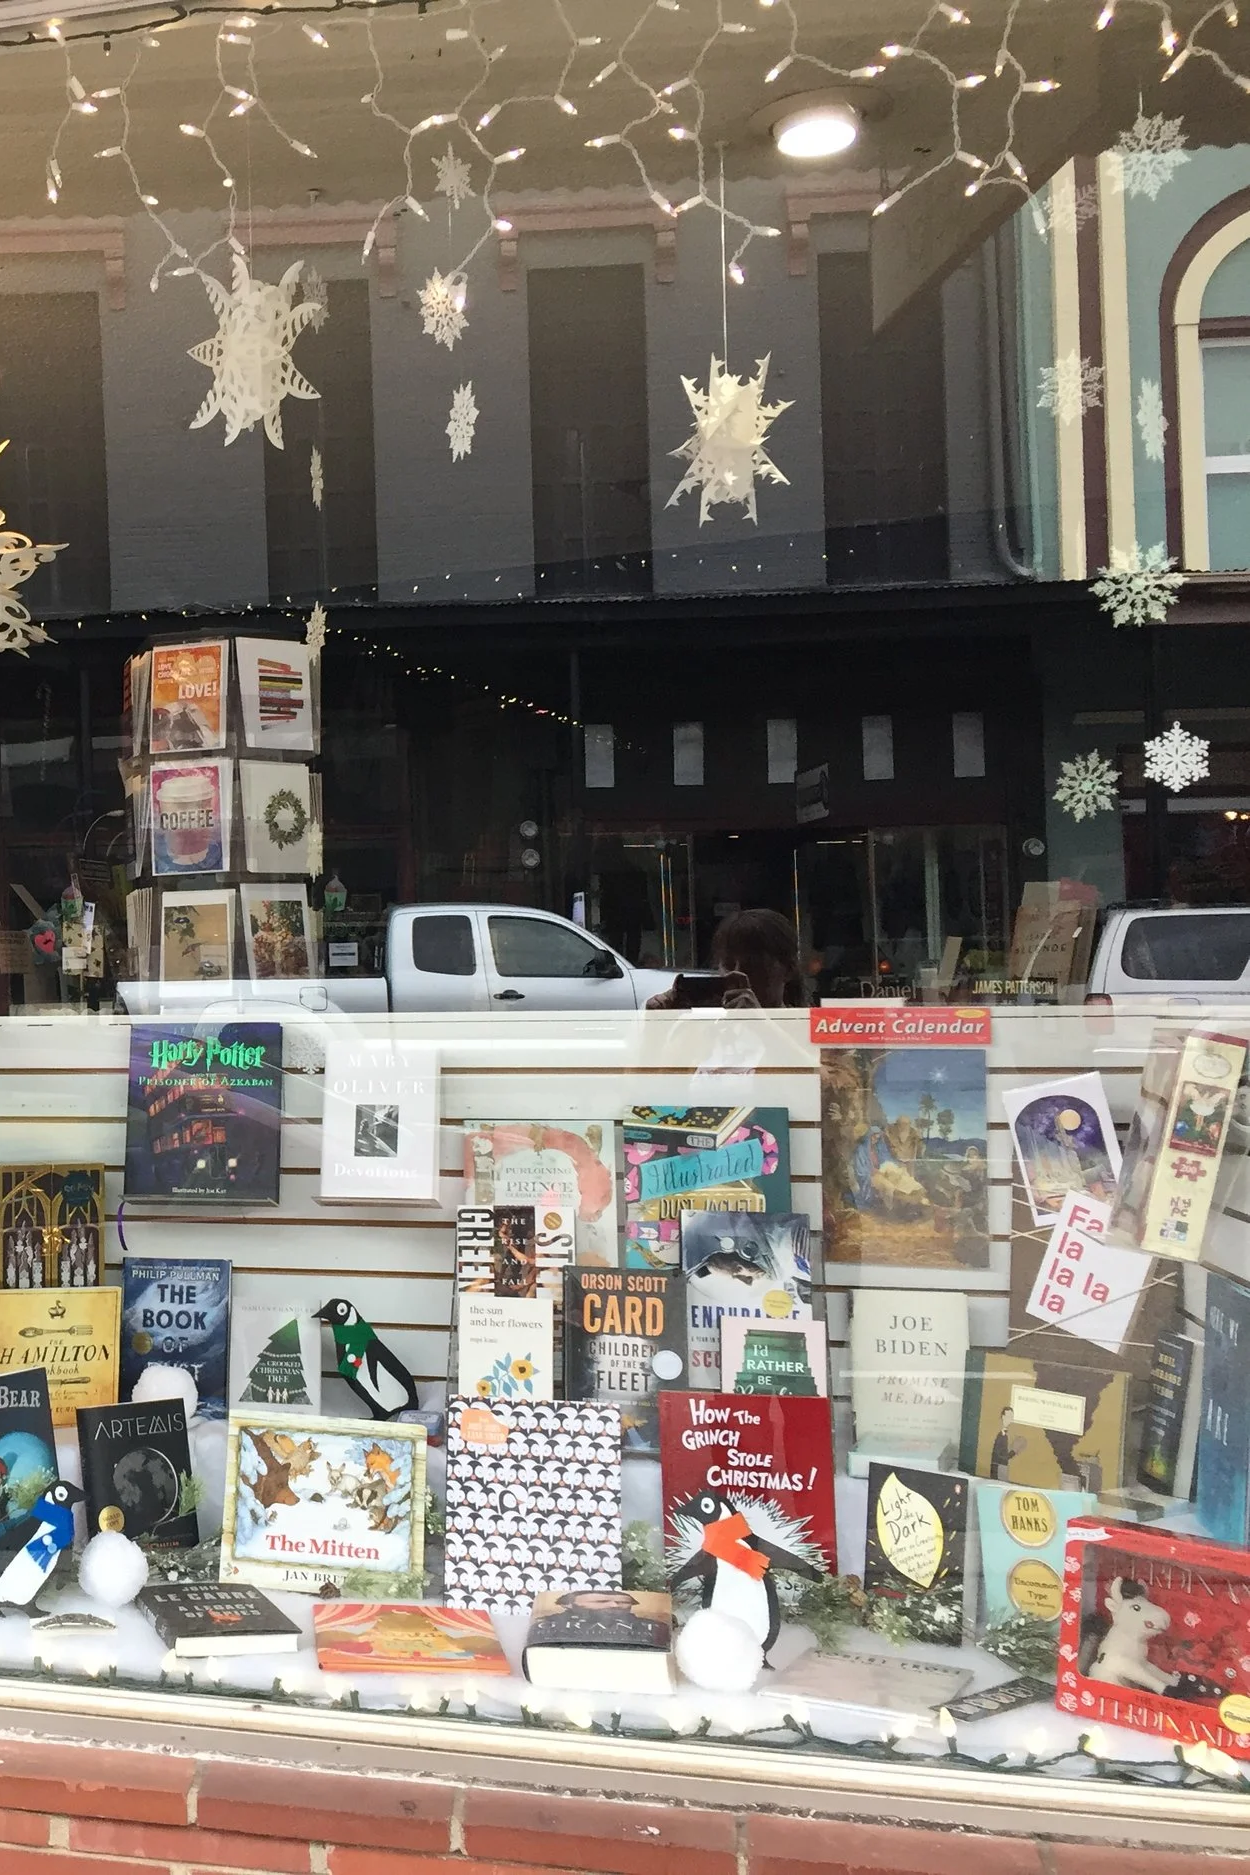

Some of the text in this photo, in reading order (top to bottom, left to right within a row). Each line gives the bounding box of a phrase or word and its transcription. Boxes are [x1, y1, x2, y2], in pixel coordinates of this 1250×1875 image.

[178, 681, 217, 699] LOVE!
[160, 809, 214, 830] COFFEE
[860, 979, 917, 998] Daniel
[972, 980, 1055, 994] JAMES PATTERSON
[815, 1019, 984, 1034] Advent Calendar
[149, 1036, 265, 1072] Harry Potter
[347, 1053, 411, 1068] MARY
[333, 1079, 425, 1095] OLIVER
[333, 1163, 418, 1180] Devotions
[649, 1145, 756, 1194] Illustrated
[506, 1181, 573, 1192] PRINCE
[660, 1198, 694, 1220] DUST
[1067, 1204, 1104, 1233] Fa
[1058, 1231, 1084, 1261] la
[170, 1270, 219, 1281] PULLMAN
[581, 1273, 668, 1293] ORSON SCOTT
[1048, 1258, 1110, 1302] la la
[157, 1284, 197, 1304] THE
[1038, 1283, 1065, 1314] la
[142, 1309, 208, 1330] BOOK
[583, 1293, 664, 1336] CARD
[889, 1315, 933, 1331] JOE
[162, 1336, 188, 1353] OF
[589, 1341, 658, 1358] CHILDREN
[876, 1339, 948, 1356] BIDEN
[747, 1360, 805, 1373] RATHER
[598, 1371, 651, 1392] FLEET
[877, 1374, 949, 1389] PROMISE
[881, 1392, 945, 1406] ME, DAD
[94, 1412, 184, 1440] ARTEMIS
[682, 1429, 741, 1450] GRINCH
[726, 1449, 773, 1468] STOLE
[879, 1487, 912, 1521] Light
[1015, 1497, 1039, 1512] TOM
[886, 1512, 932, 1545] Dark
[1012, 1515, 1048, 1533] HANKS
[265, 1534, 380, 1560] The Mitten
[282, 1570, 310, 1582] JAN
[1014, 1577, 1059, 1590] Uncommon
